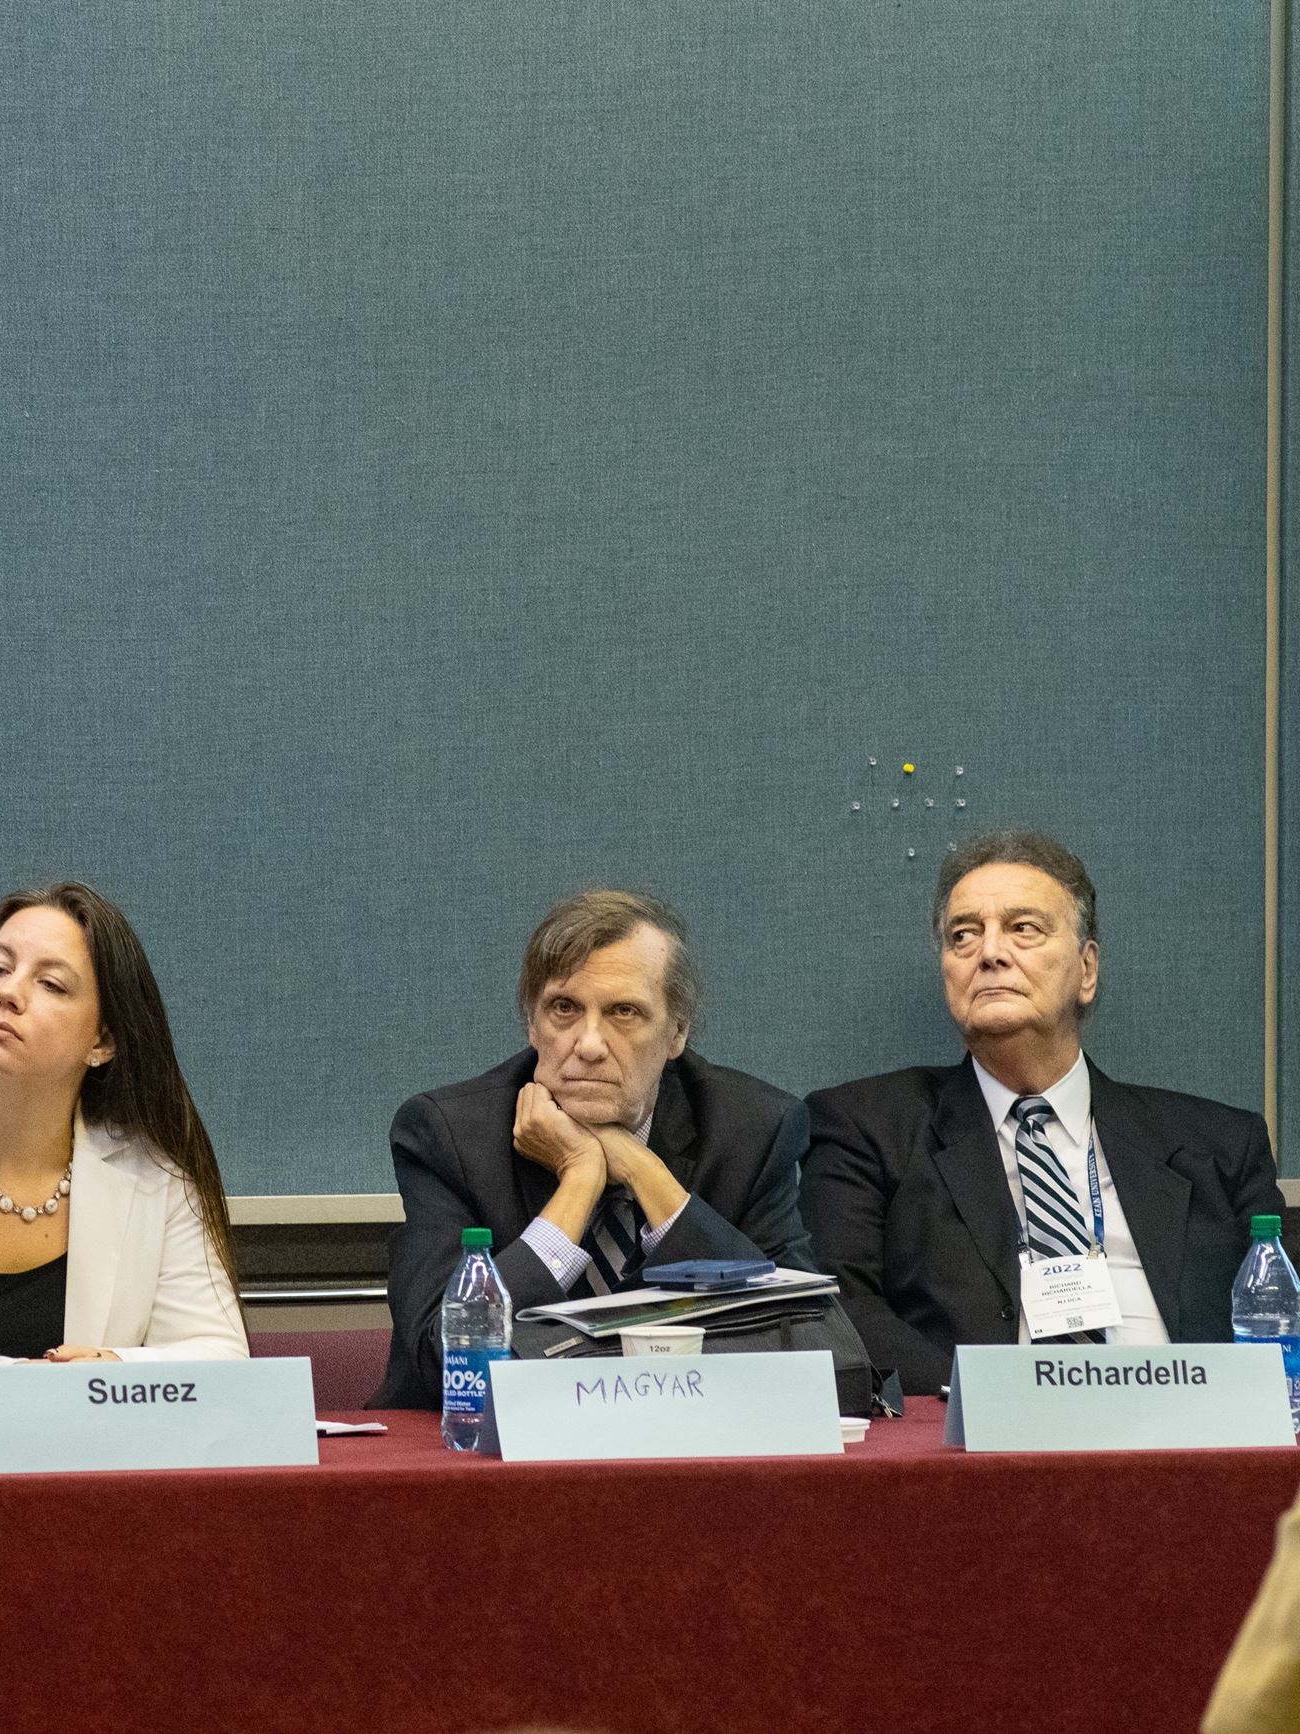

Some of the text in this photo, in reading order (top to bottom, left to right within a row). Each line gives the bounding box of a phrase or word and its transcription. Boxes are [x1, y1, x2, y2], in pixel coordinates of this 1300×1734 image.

[1088, 1153, 1100, 1197] UNIVERSITY
[1042, 1263, 1082, 1276] 2022
[1049, 1281, 1082, 1290] RICHARD
[649, 1345, 671, 1353] 12oz
[443, 1370, 486, 1390] 00%
[1034, 1359, 1208, 1386] Richardella
[88, 1378, 198, 1405] Suarez
[576, 1369, 704, 1406] MAGYAR
